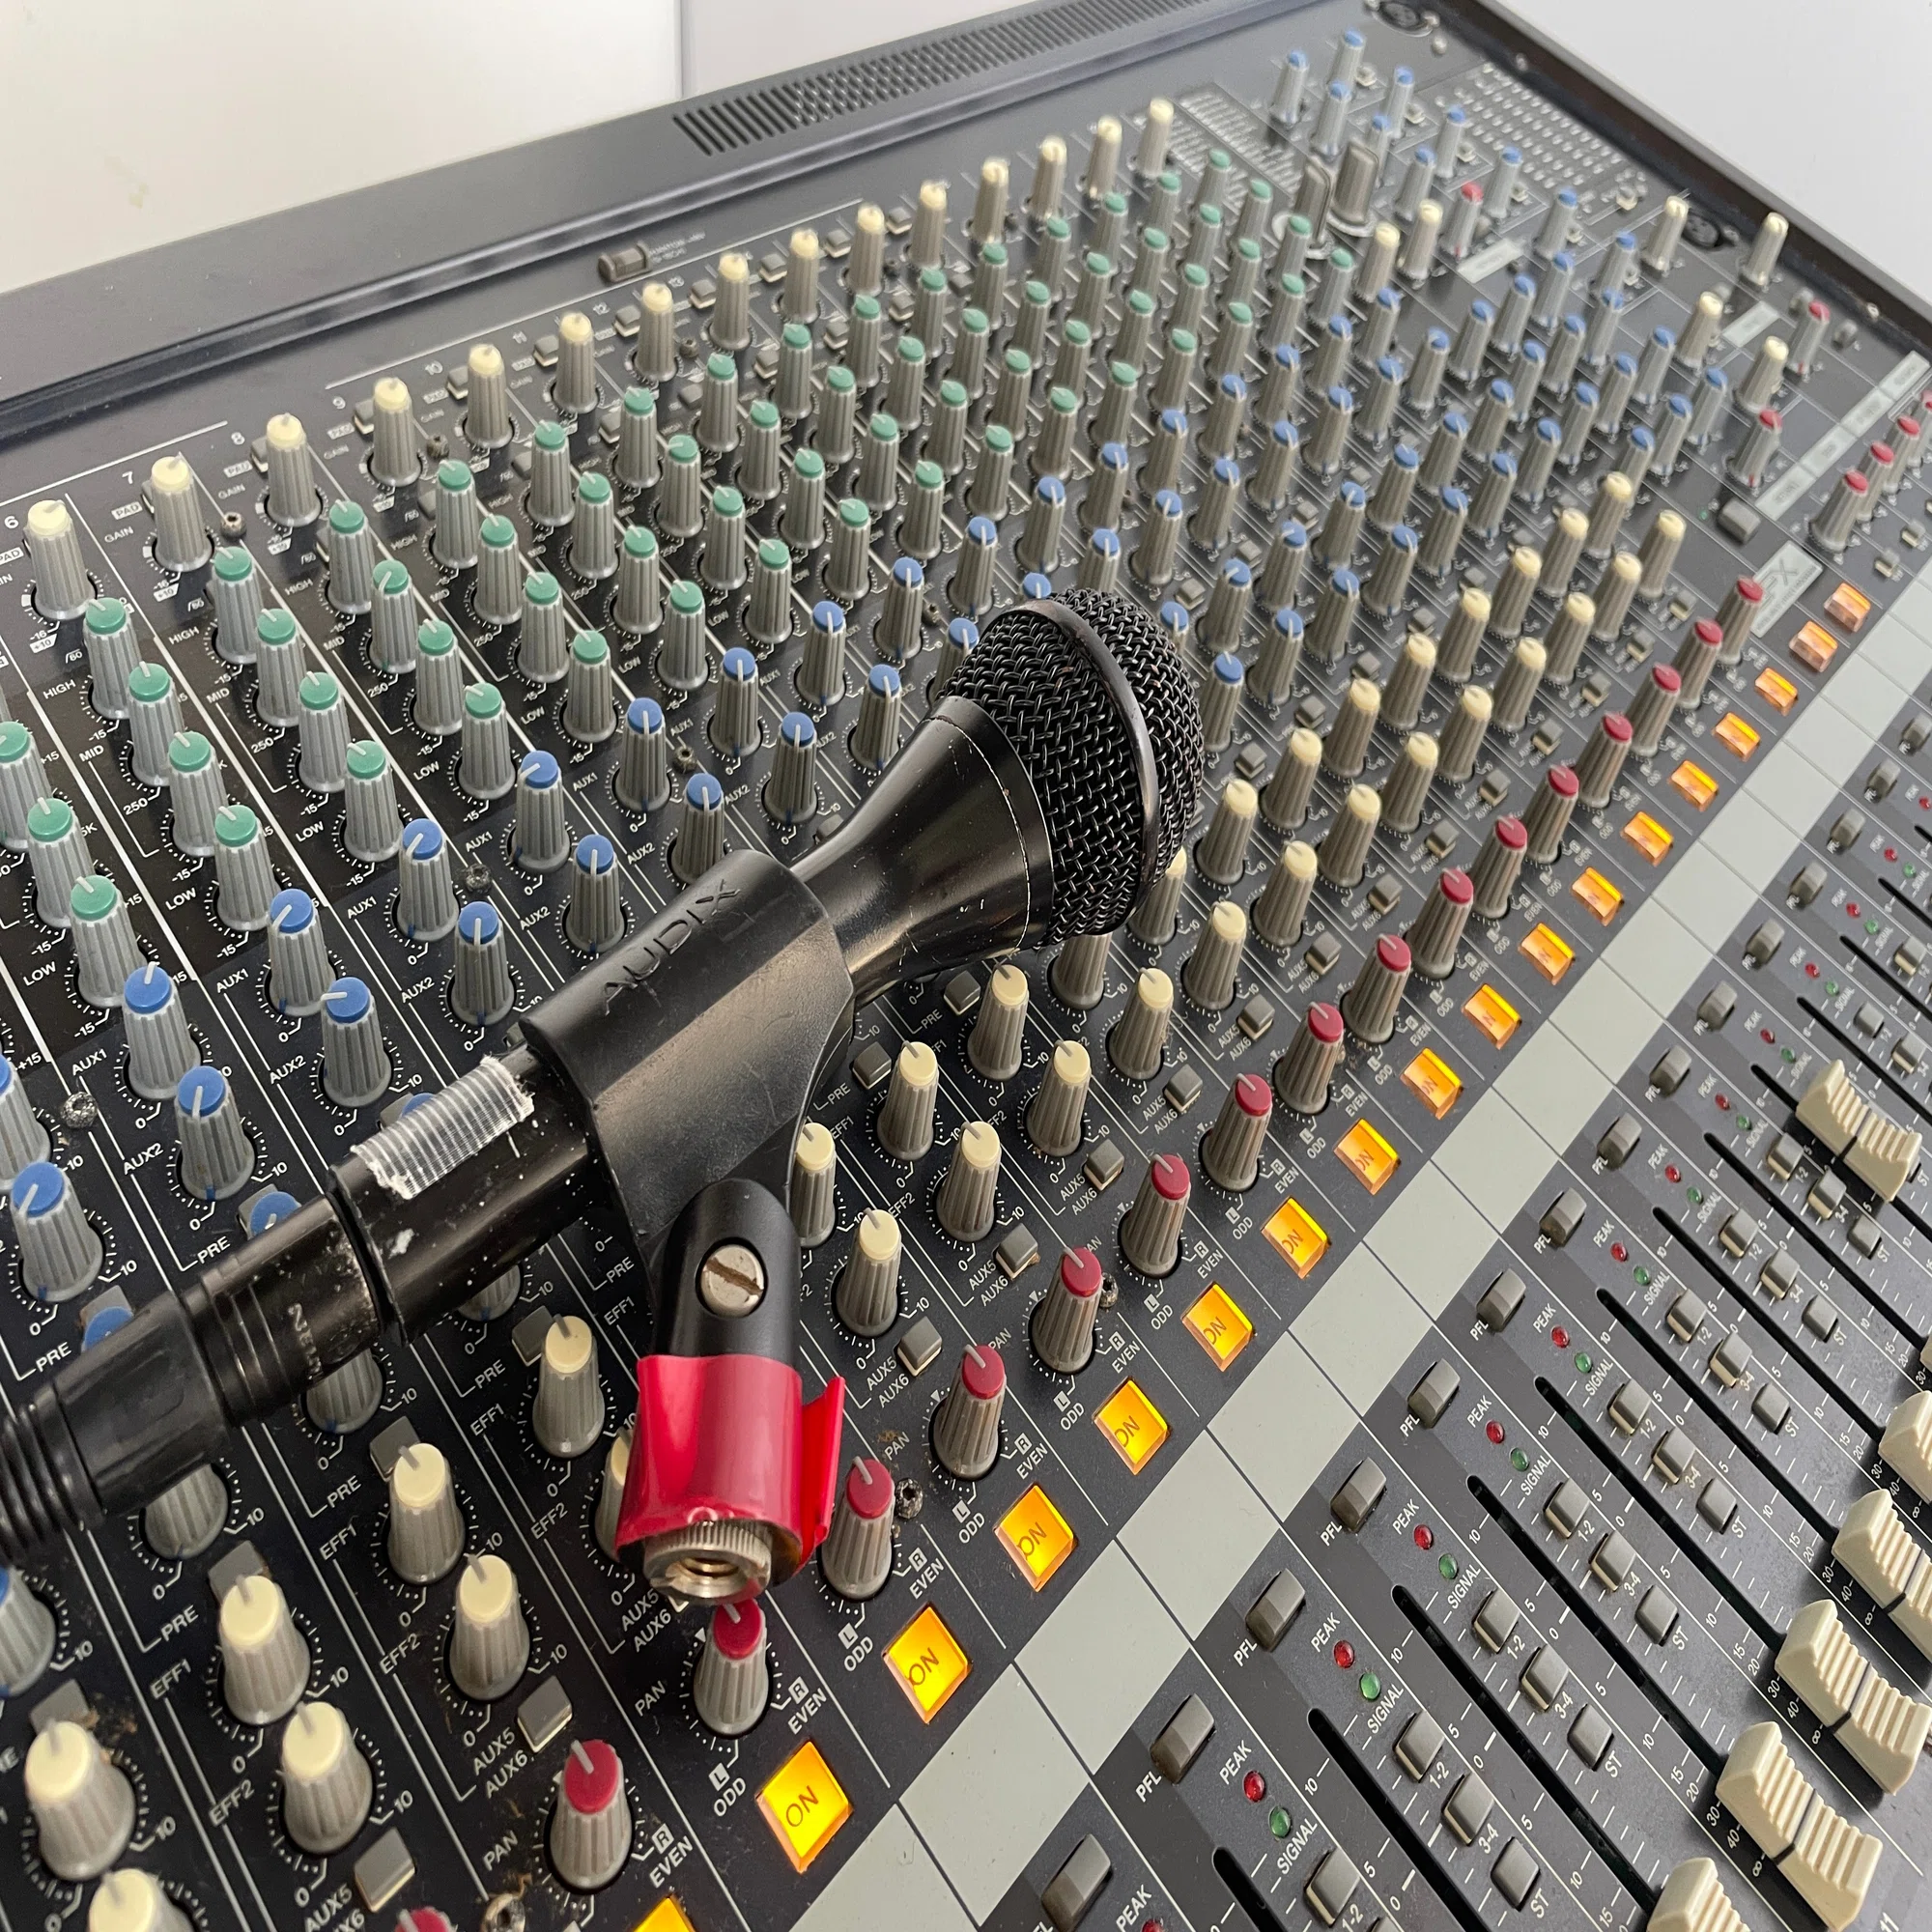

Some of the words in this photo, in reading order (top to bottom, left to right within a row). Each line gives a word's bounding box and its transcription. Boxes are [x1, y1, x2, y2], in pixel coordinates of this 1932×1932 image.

[232, 432, 245, 445] 8
[122, 470, 134, 484] 7
[4, 515, 19, 529] 6
[115, 503, 139, 517] PAD
[104, 526, 134, 544] GAIN
[286, 578, 314, 595] HIGH
[169, 627, 200, 645] HIGH
[324, 636, 346, 651] MID
[43, 679, 76, 699] HIGH
[207, 688, 230, 703] MID
[369, 681, 389, 696] 250
[521, 706, 546, 724] LOW
[89, 729, 108, 742] -15
[251, 737, 275, 753] 250
[78, 745, 105, 762] MID
[412, 761, 440, 781] LOW
[572, 774, 599, 791] AUX1
[123, 797, 148, 815] 250
[724, 785, 752, 806] AUX2
[299, 803, 320, 816] -15
[296, 820, 324, 842] LOW
[465, 832, 494, 851] AUX1
[627, 842, 656, 865] AUX2
[172, 868, 192, 884] -15
[346, 873, 365, 887] -15
[165, 887, 197, 911] LOW
[347, 896, 378, 919] AUX1
[519, 906, 551, 930] AUX2
[31, 941, 52, 956] -15
[217, 944, 237, 958] -15
[22, 961, 56, 986] LOW
[216, 968, 249, 993] AUX1
[401, 977, 435, 1003] AUX2
[73, 1023, 96, 1038] -15
[921, 1010, 943, 1029] PRE
[1218, 1027, 1239, 1048] AUX5
[71, 1048, 108, 1075] AUX1
[1231, 1039, 1251, 1062] AUX6
[269, 1055, 306, 1085] AUX2
[827, 1083, 851, 1104] PRE
[1143, 1095, 1166, 1122] AUX5
[1153, 1109, 1178, 1134] AUX6
[122, 1143, 165, 1175] AUX2
[1307, 1138, 1325, 1158] ODD
[1059, 1172, 1087, 1201] AUX5
[1275, 1167, 1299, 1195] EVEN
[1071, 1187, 1097, 1214] AUX6
[1233, 1216, 1254, 1240] ODD
[1592, 1219, 1613, 1247] PEAK
[198, 1236, 232, 1264] PRE
[1534, 1235, 1551, 1254] PFL
[607, 1257, 635, 1283] PRE
[969, 1261, 997, 1291] AUX5
[1197, 1249, 1224, 1279] EVEN
[980, 1275, 1009, 1306] AUX6
[1643, 1270, 1668, 1306] SIGNAL
[604, 1296, 635, 1325] EFF1
[1151, 1305, 1173, 1329] ODD
[1533, 1303, 1556, 1333] PEAK
[1470, 1321, 1489, 1341] PFL
[1833, 1328, 1847, 1345] ST
[35, 1342, 72, 1372] PRE
[1112, 1340, 1141, 1374] EVEN
[475, 1360, 506, 1389] PRE
[866, 1356, 896, 1391] AUX5
[1583, 1358, 1612, 1396] SIGNAL
[1739, 1370, 1754, 1390] 3-4
[878, 1374, 910, 1408] AUX6
[469, 1404, 505, 1435] EFF1
[1060, 1403, 1085, 1431] ODD
[1467, 1396, 1492, 1428] PEAK
[1400, 1415, 1420, 1436] PFL
[1638, 1419, 1656, 1438] 1-2
[1784, 1418, 1798, 1436] ST
[885, 1431, 911, 1461] PAN
[1016, 1443, 1048, 1479] EVEN
[1520, 1455, 1551, 1495] SIGNAL
[1685, 1467, 1700, 1487] 3-4
[327, 1475, 362, 1506] PRE
[530, 1502, 569, 1540] EFF2
[958, 1513, 985, 1544] ODD
[1392, 1499, 1420, 1534] PEAK
[1731, 1519, 1745, 1538] ST
[321, 1523, 357, 1559] EFF1
[1321, 1521, 1343, 1546] PFL
[910, 1558, 945, 1599] EVEN
[1624, 1573, 1641, 1596] 3-4
[1823, 1565, 1835, 1583] 30
[1447, 1565, 1481, 1609] SIGNAL
[1841, 1584, 1854, 1602] 40
[620, 1589, 659, 1631] AUX5
[160, 1605, 199, 1641] PRE
[633, 1608, 672, 1653] AUX6
[1311, 1612, 1342, 1653] PEAK
[1507, 1635, 1525, 1660] 1-2
[1673, 1626, 1690, 1651] ST
[379, 1634, 421, 1674] EFF2
[844, 1636, 873, 1672] ODD
[1234, 1639, 1258, 1665] PFL
[150, 1659, 193, 1698] EFF1
[909, 1647, 939, 1687] ON
[1748, 1658, 1760, 1675] 20
[635, 1680, 667, 1716] PAN
[1768, 1681, 1781, 1699] 30
[787, 1688, 827, 1734] EVEN
[1367, 1684, 1405, 1735] SIGNAL
[1555, 1693, 1574, 1719] 3-4
[1787, 1700, 1799, 1719] 40
[471, 1726, 516, 1776] AUX5
[1219, 1741, 1252, 1784] PEAK
[1605, 1750, 1624, 1777] ST
[485, 1749, 528, 1799] AUX6
[1430, 1763, 1450, 1788] 1-2
[713, 1777, 747, 1817] ODD
[1135, 1772, 1161, 1802] PFL
[1687, 1782, 1699, 1802] 20
[209, 1779, 254, 1825] EFF2
[785, 1785, 819, 1828] ON
[1706, 1806, 1720, 1826] 30
[483, 1831, 519, 1870] PAN
[1277, 1818, 1319, 1875] SIGNAL
[1479, 1824, 1499, 1853] 3-4
[1727, 1829, 1740, 1849] 40
[649, 1836, 694, 1888] EVEN
[1531, 1889, 1550, 1918] ST
